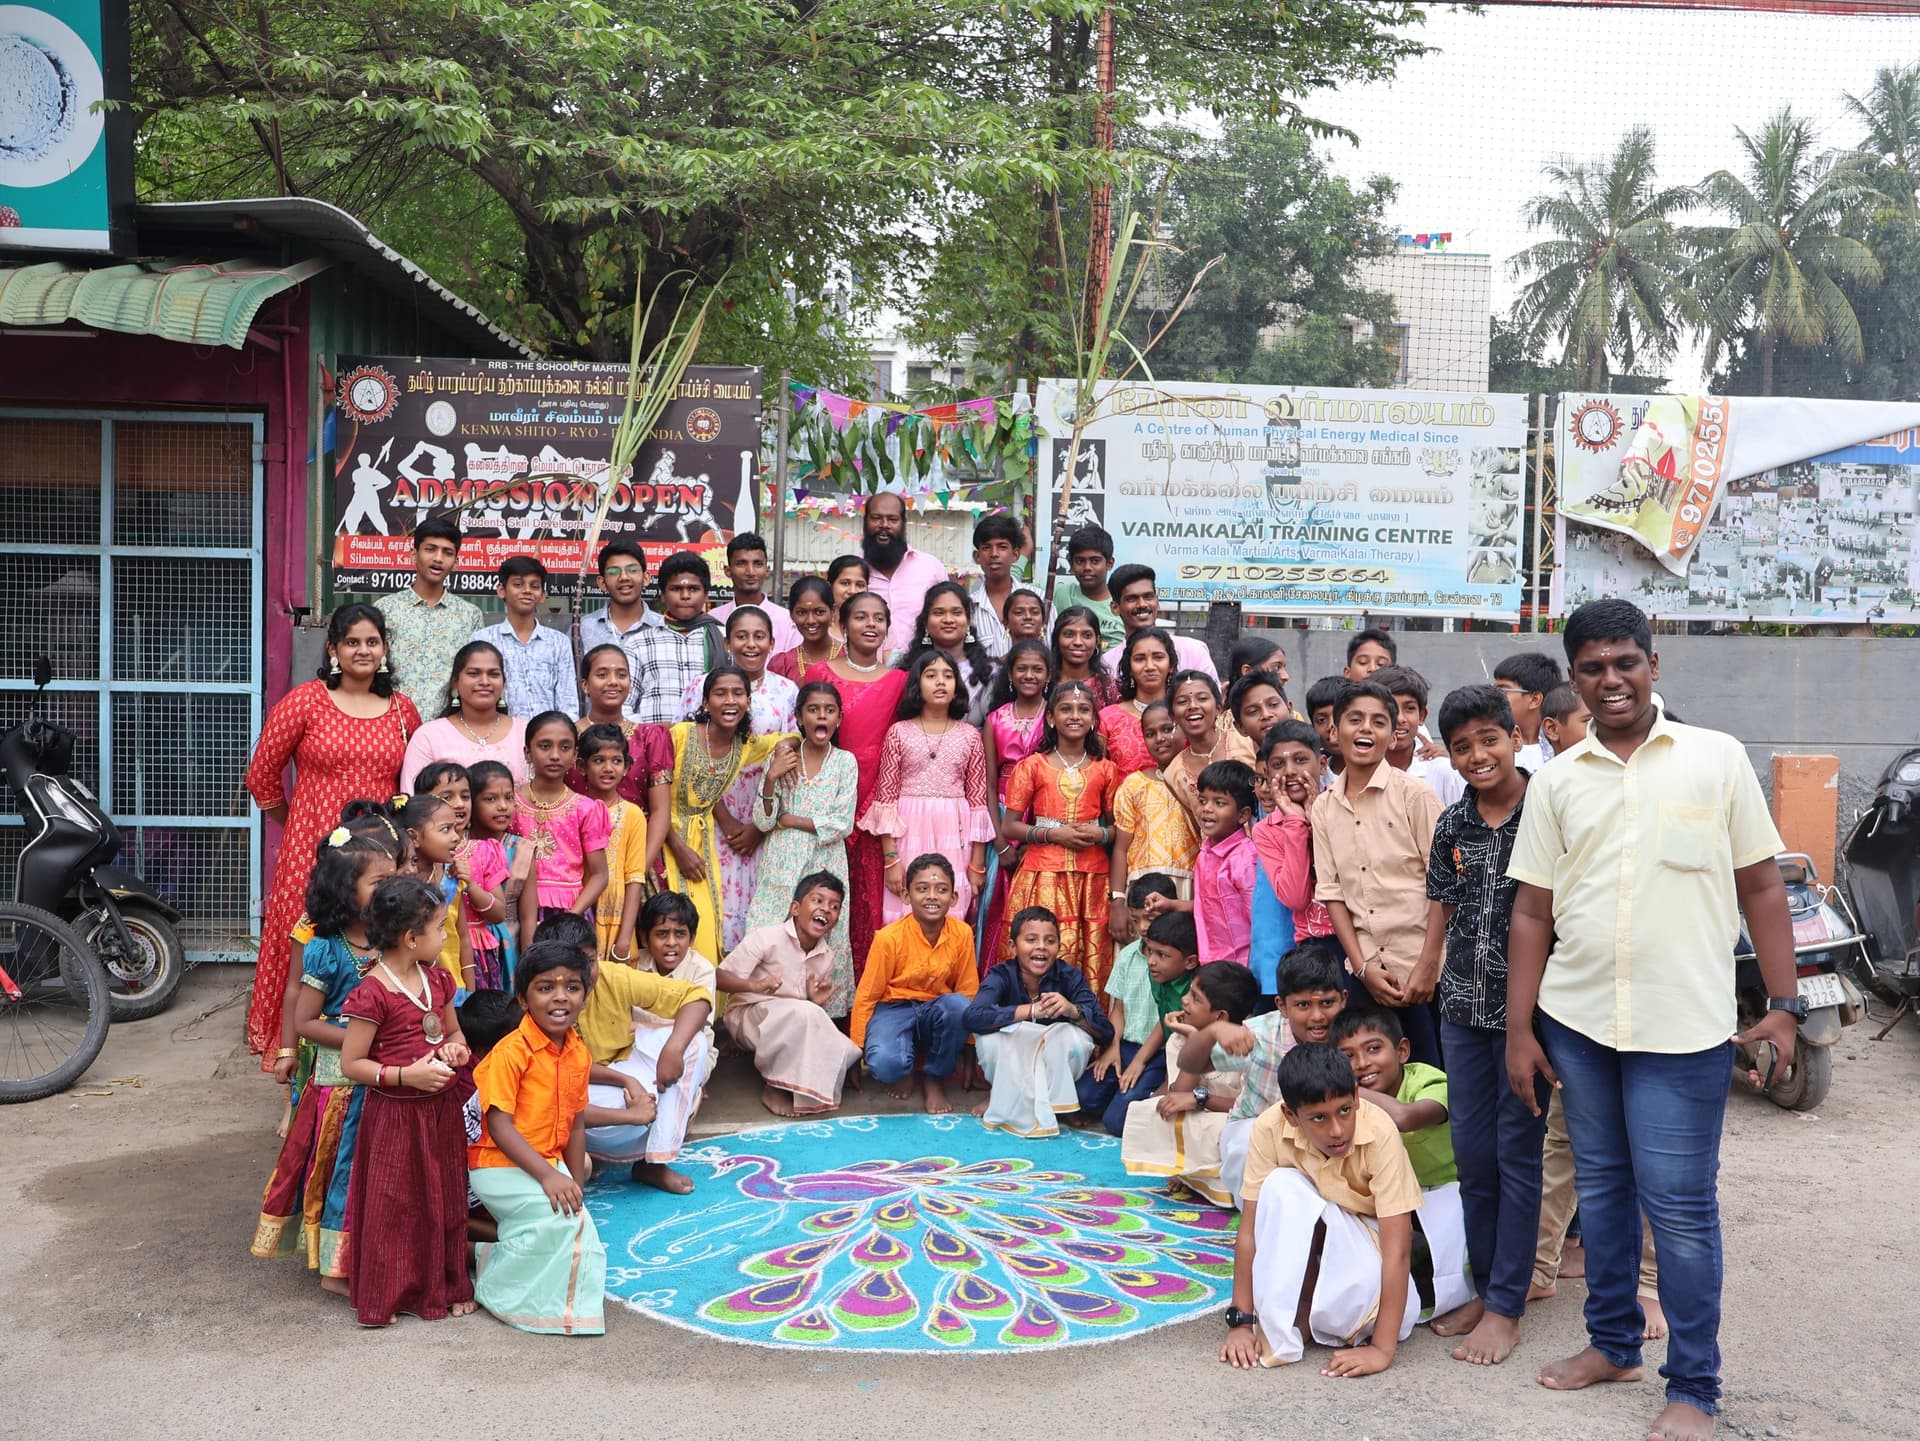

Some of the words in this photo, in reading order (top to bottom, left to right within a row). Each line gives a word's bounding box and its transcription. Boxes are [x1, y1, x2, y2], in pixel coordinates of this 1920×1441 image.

[488, 361, 508, 370] RRB
[515, 362, 534, 371] THE
[536, 363, 576, 372] SCHOOL
[578, 363, 590, 372] OF
[592, 364, 631, 373] MARTIAL
[407, 370, 435, 394] தமிழ்
[437, 372, 495, 395] பாரம்பரிய
[497, 373, 582, 398] தற்காப்புக்கலை
[585, 375, 613, 396] கல்வி
[713, 380, 752, 400] மையம்
[545, 408, 603, 424] சிலம்பம்
[1111, 387, 1250, 418] போகர்
[1264, 390, 1495, 428] வர்மாலயம்
[461, 424, 511, 437] KENWA
[515, 425, 557, 438] SHITO
[570, 426, 599, 438] RYO
[650, 429, 683, 441] NDIA
[1134, 422, 1143, 434] A
[1147, 423, 1192, 436] Centre
[1195, 424, 1209, 436] of
[1214, 425, 1258, 437] Human
[1263, 426, 1317, 440] Physical
[1321, 428, 1366, 443] Energy
[1370, 430, 1419, 443] Medical
[1424, 431, 1459, 443] Since
[1301, 444, 1369, 465] வர்மக்கலை
[1372, 446, 1411, 466] சங்கம்
[388, 476, 598, 513] ADMISSION
[608, 482, 705, 515] OPEN
[1119, 477, 1263, 499] வர்மக்கலை
[1272, 480, 1360, 503] பயிற்சி
[1369, 483, 1455, 504] மையம்
[461, 517, 505, 528] Students
[508, 517, 529, 529] Skill
[533, 518, 595, 531] Developmen
[601, 519, 623, 532] Day
[1121, 521, 1264, 539] VARMAKALAI
[1269, 524, 1369, 542] TRAINING
[1375, 528, 1453, 545] CENTRE
[350, 536, 385, 551] சிலம்பம்,
[1163, 543, 1199, 556] Varma
[1202, 544, 1230, 557] Kalai
[1233, 545, 1271, 558] Martial
[1300, 546, 1338, 559] Varma
[1340, 547, 1367, 560] Kalai
[1370, 548, 1414, 563] Therapy
[350, 553, 394, 566] Silambam,
[458, 555, 486, 568] Kalari,
[337, 574, 365, 585] Contact
[1180, 564, 1389, 584] 9710255664
